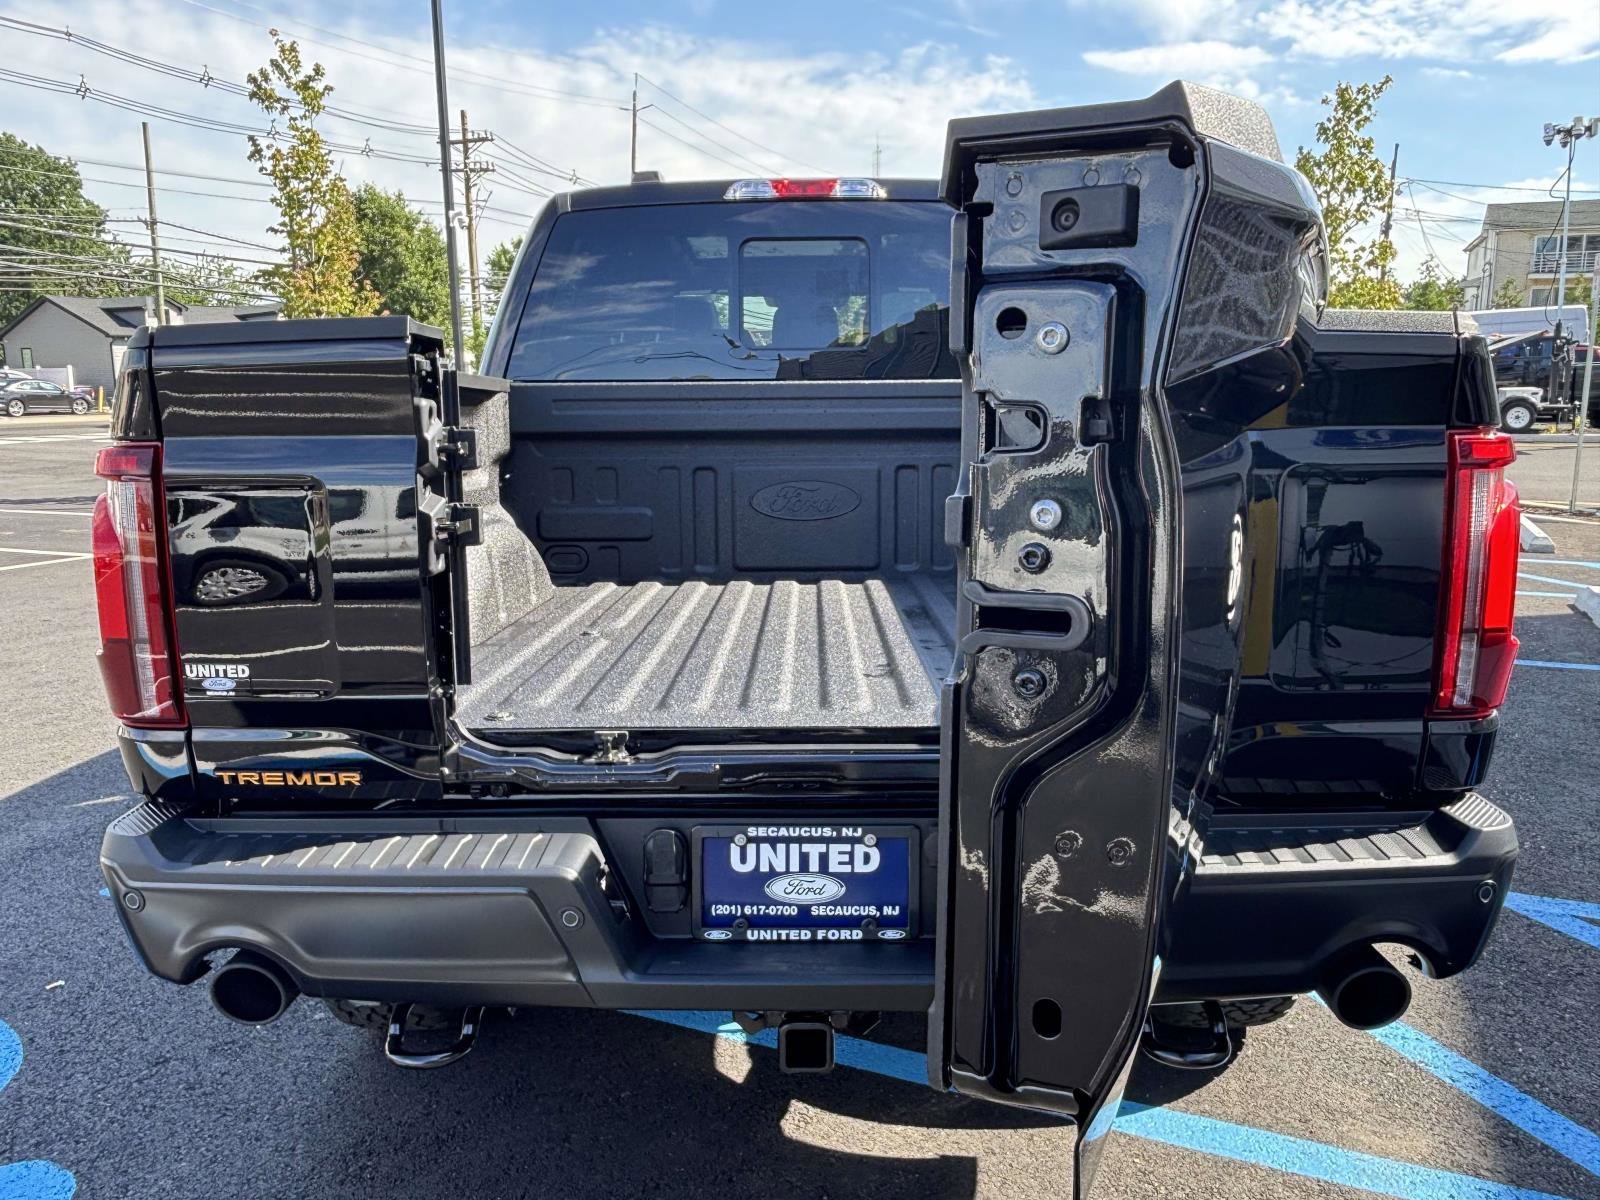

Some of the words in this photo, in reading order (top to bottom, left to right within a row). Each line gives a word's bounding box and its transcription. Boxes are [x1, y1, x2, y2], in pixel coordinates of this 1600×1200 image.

[769, 485, 840, 513] Ford
[184, 663, 250, 678] UNITED
[215, 770, 363, 786] TREMOR
[747, 827, 837, 838] SECAUCUS,
[842, 827, 863, 837] NJ
[730, 843, 881, 873] UNITED
[783, 878, 827, 896] Ford
[711, 905, 742, 916] (201)
[744, 905, 798, 916] 617-0700
[811, 905, 880, 917] SECAUCUS,
[883, 905, 900, 916] NJ
[746, 930, 812, 940] UNITED
[817, 930, 863, 940] FORD
